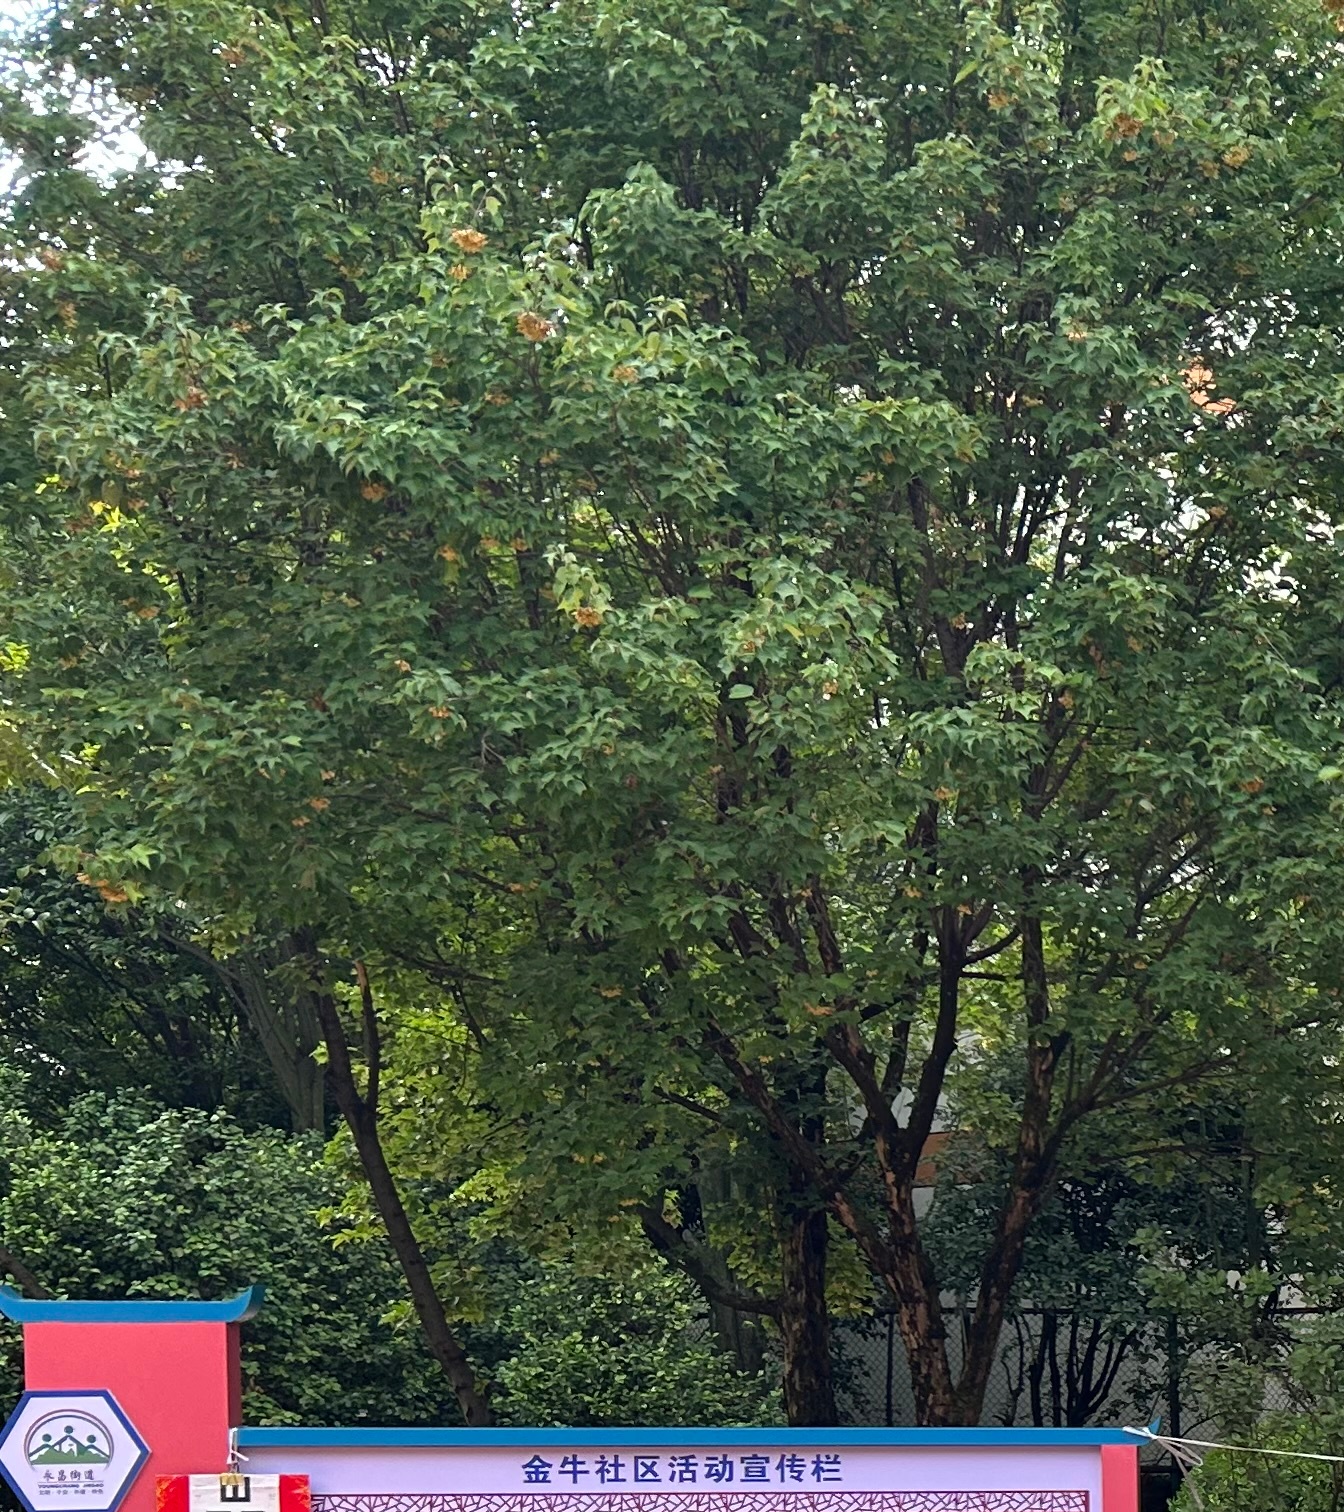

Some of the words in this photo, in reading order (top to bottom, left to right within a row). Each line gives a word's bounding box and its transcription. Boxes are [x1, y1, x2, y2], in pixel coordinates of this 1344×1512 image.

[522, 1454, 842, 1484] 金牛社区活动宣传栏
